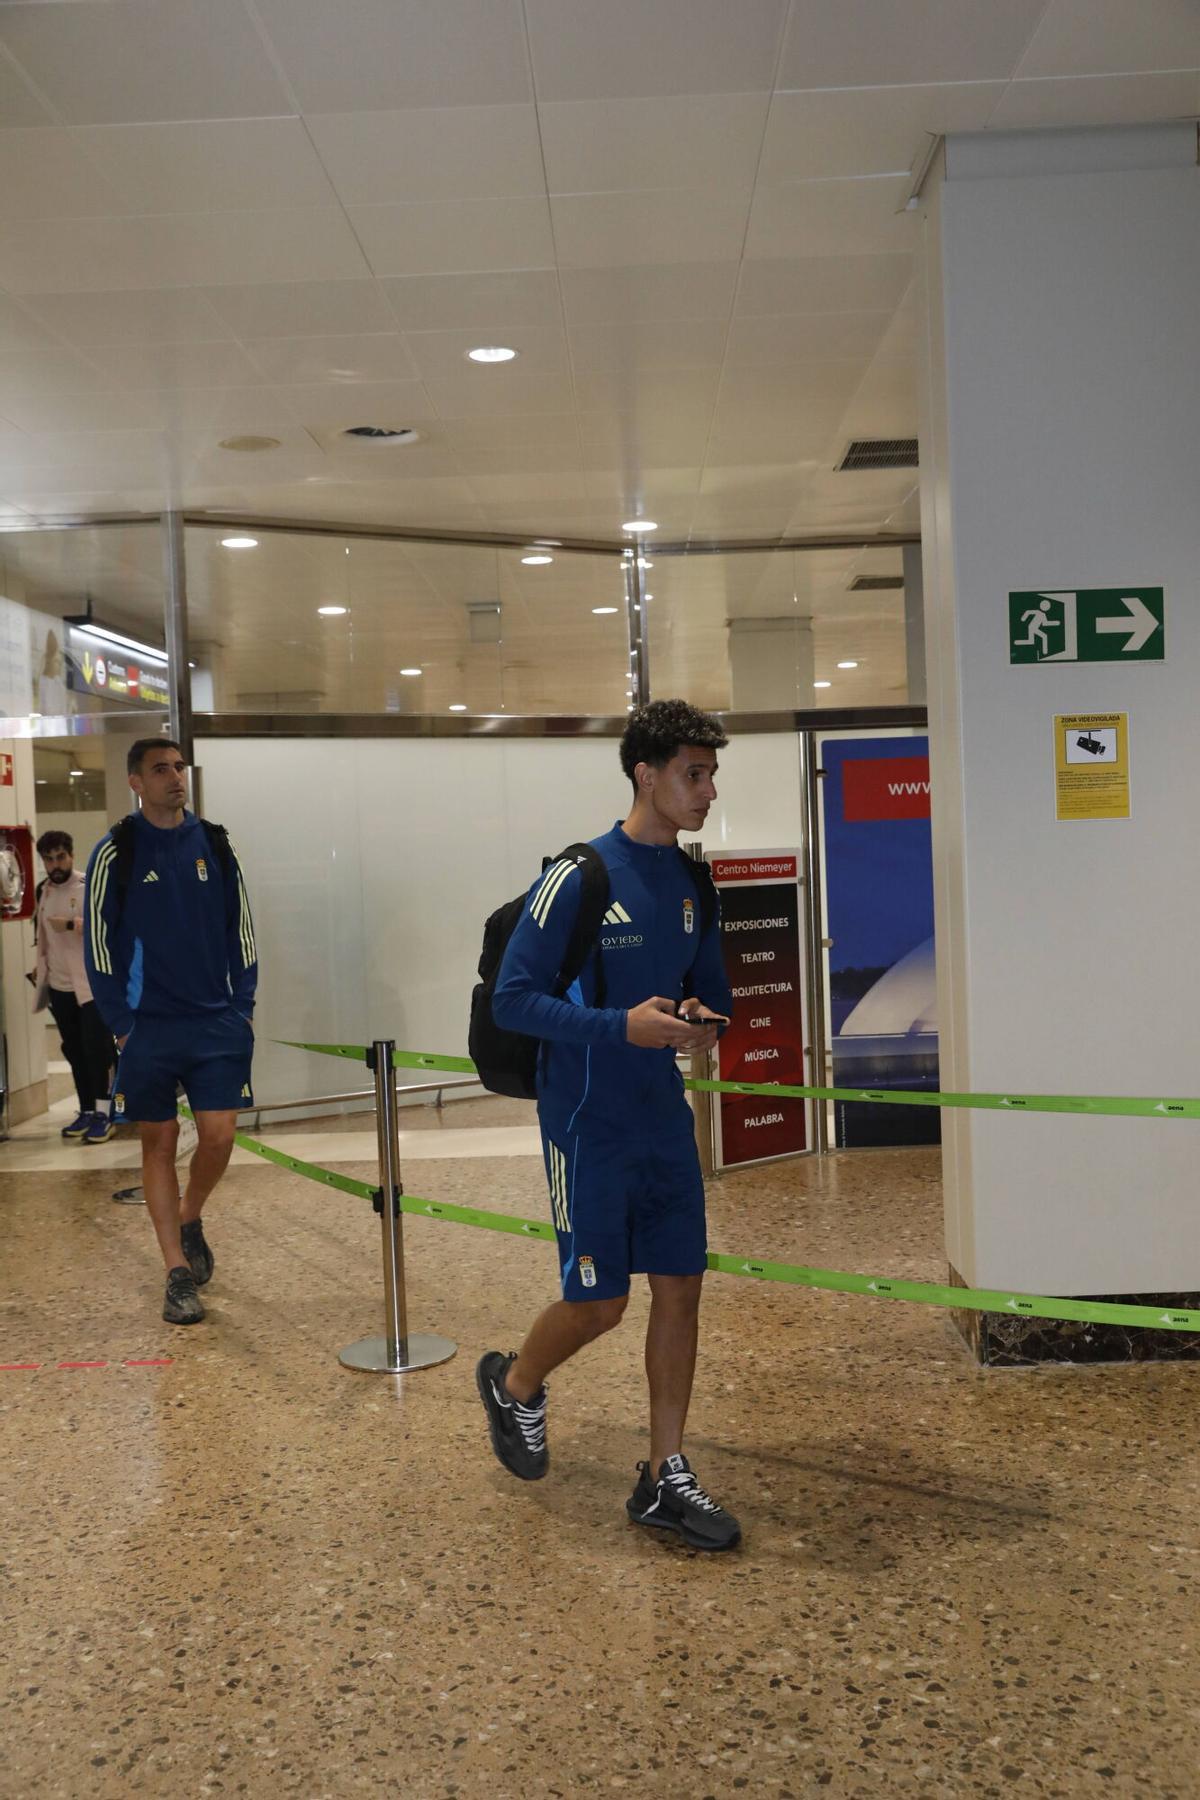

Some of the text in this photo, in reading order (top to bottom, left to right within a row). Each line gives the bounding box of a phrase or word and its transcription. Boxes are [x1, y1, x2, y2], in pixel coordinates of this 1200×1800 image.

[716, 861, 793, 876] Centro Niemeyer
[724, 917, 789, 932] EXPOSICIONES
[602, 934, 643, 946] OVIEDO
[741, 951, 775, 963] TEATRO
[729, 982, 793, 998] RQUITECTURA
[750, 1017, 771, 1029] CINE
[744, 1048, 779, 1063] MÚSICA
[744, 1112, 784, 1129] PALABRA
